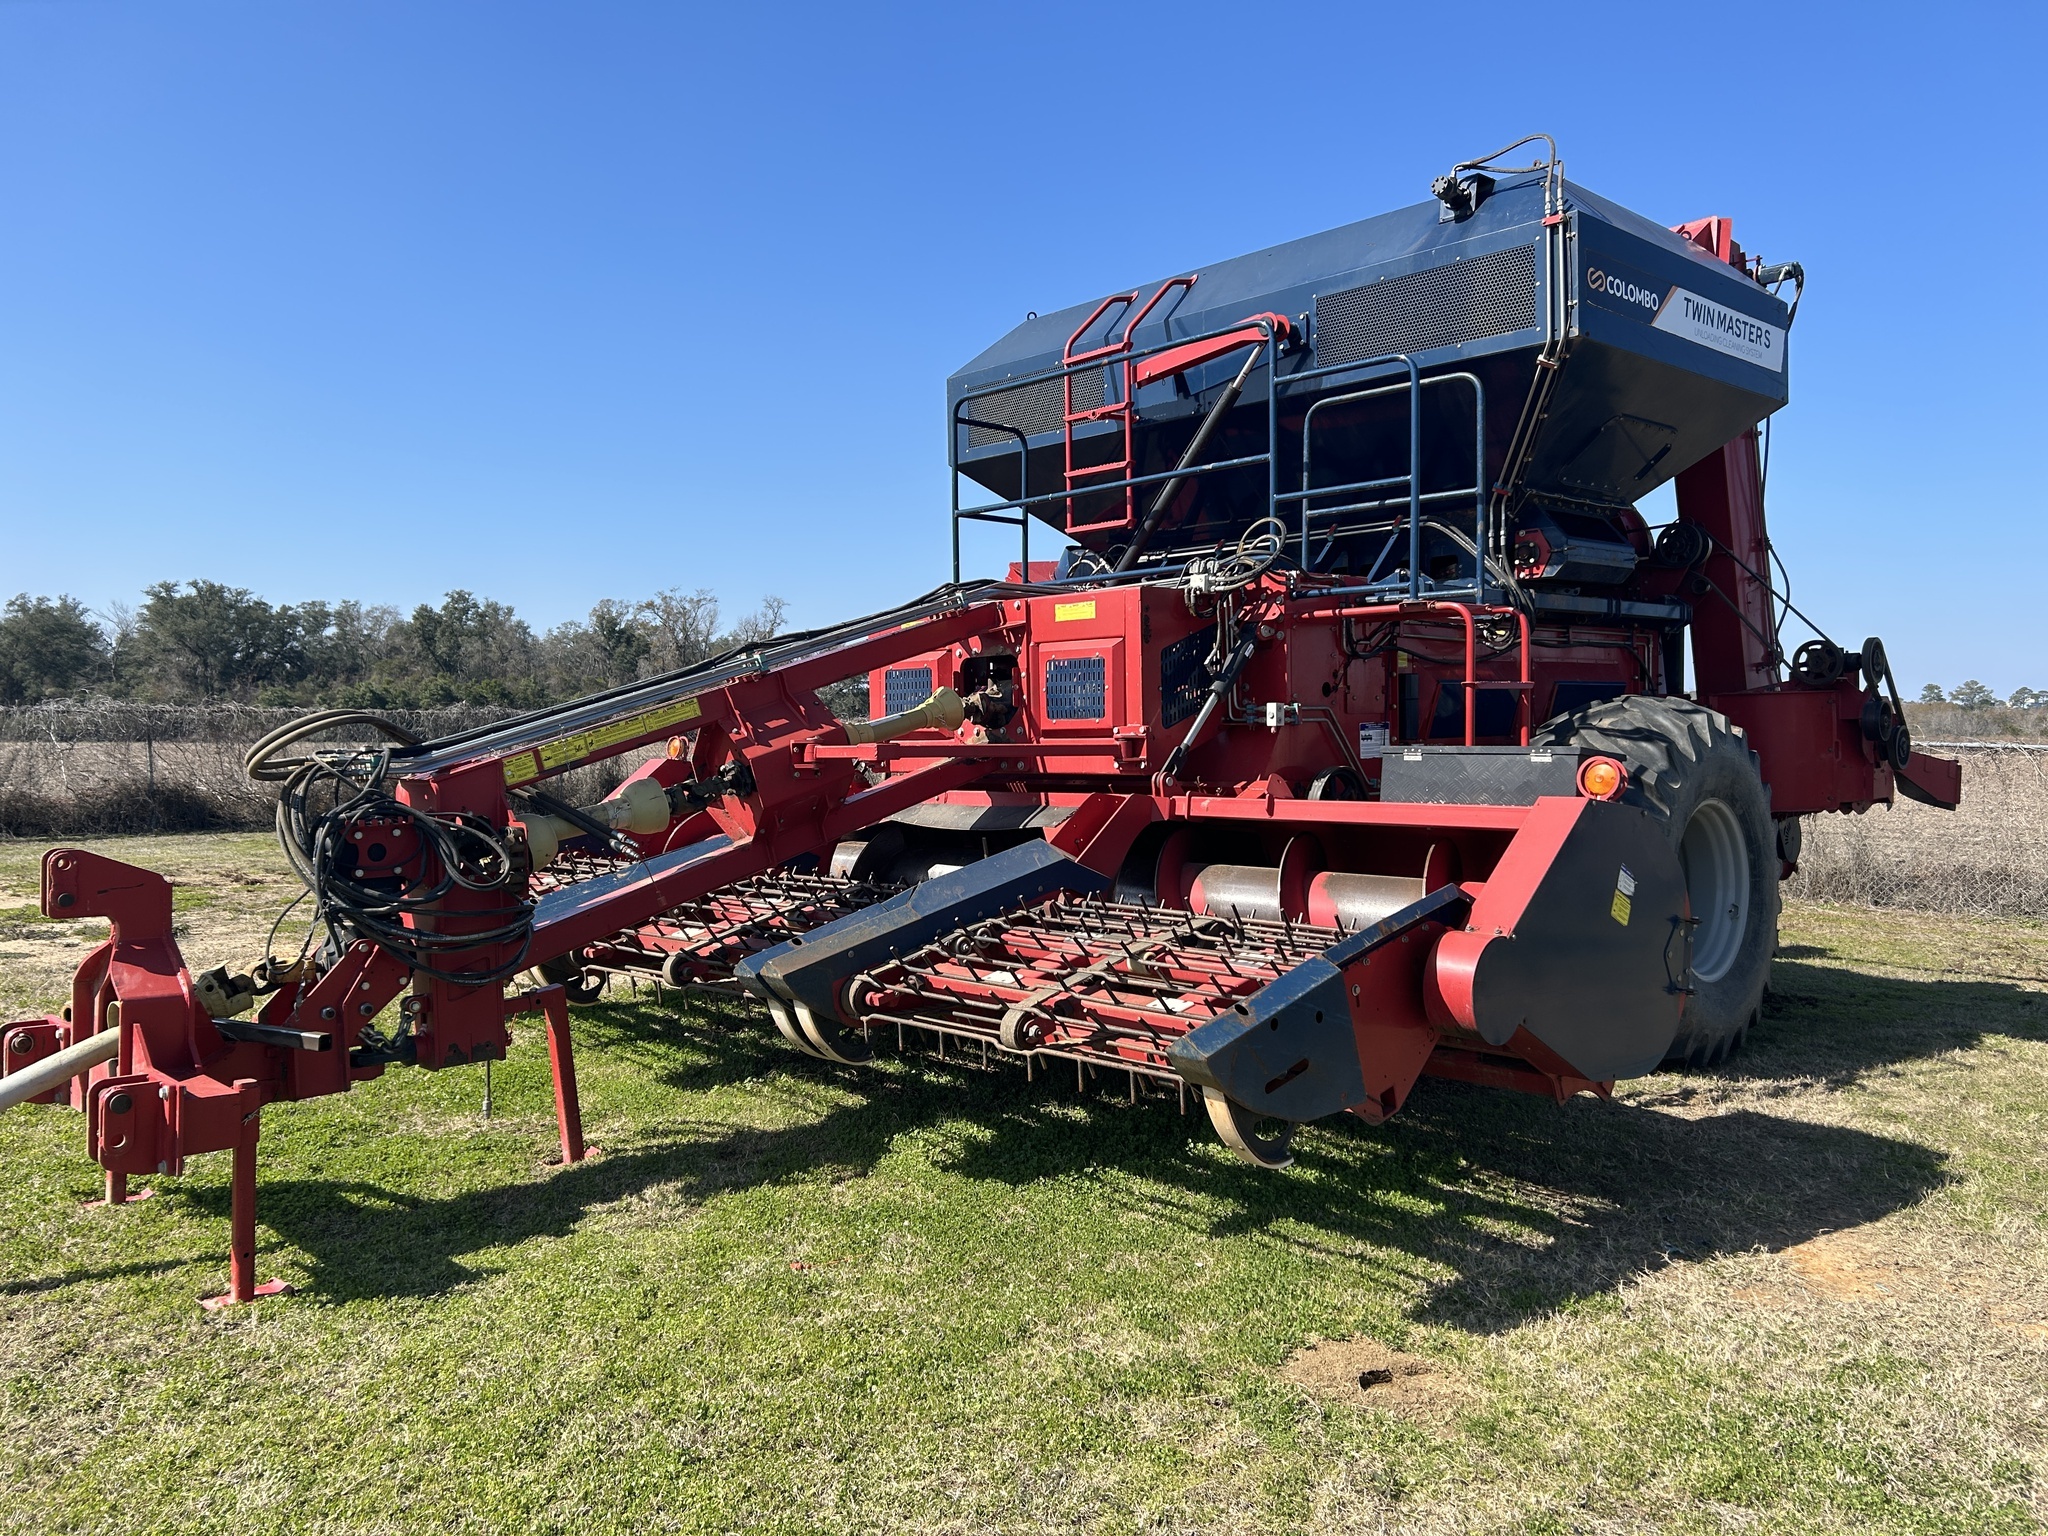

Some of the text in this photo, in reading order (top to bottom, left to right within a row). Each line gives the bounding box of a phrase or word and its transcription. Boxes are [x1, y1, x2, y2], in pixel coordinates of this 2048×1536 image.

[1606, 275, 1659, 311] COLOMBO
[1684, 297, 1771, 349] TWIN MASTERS
